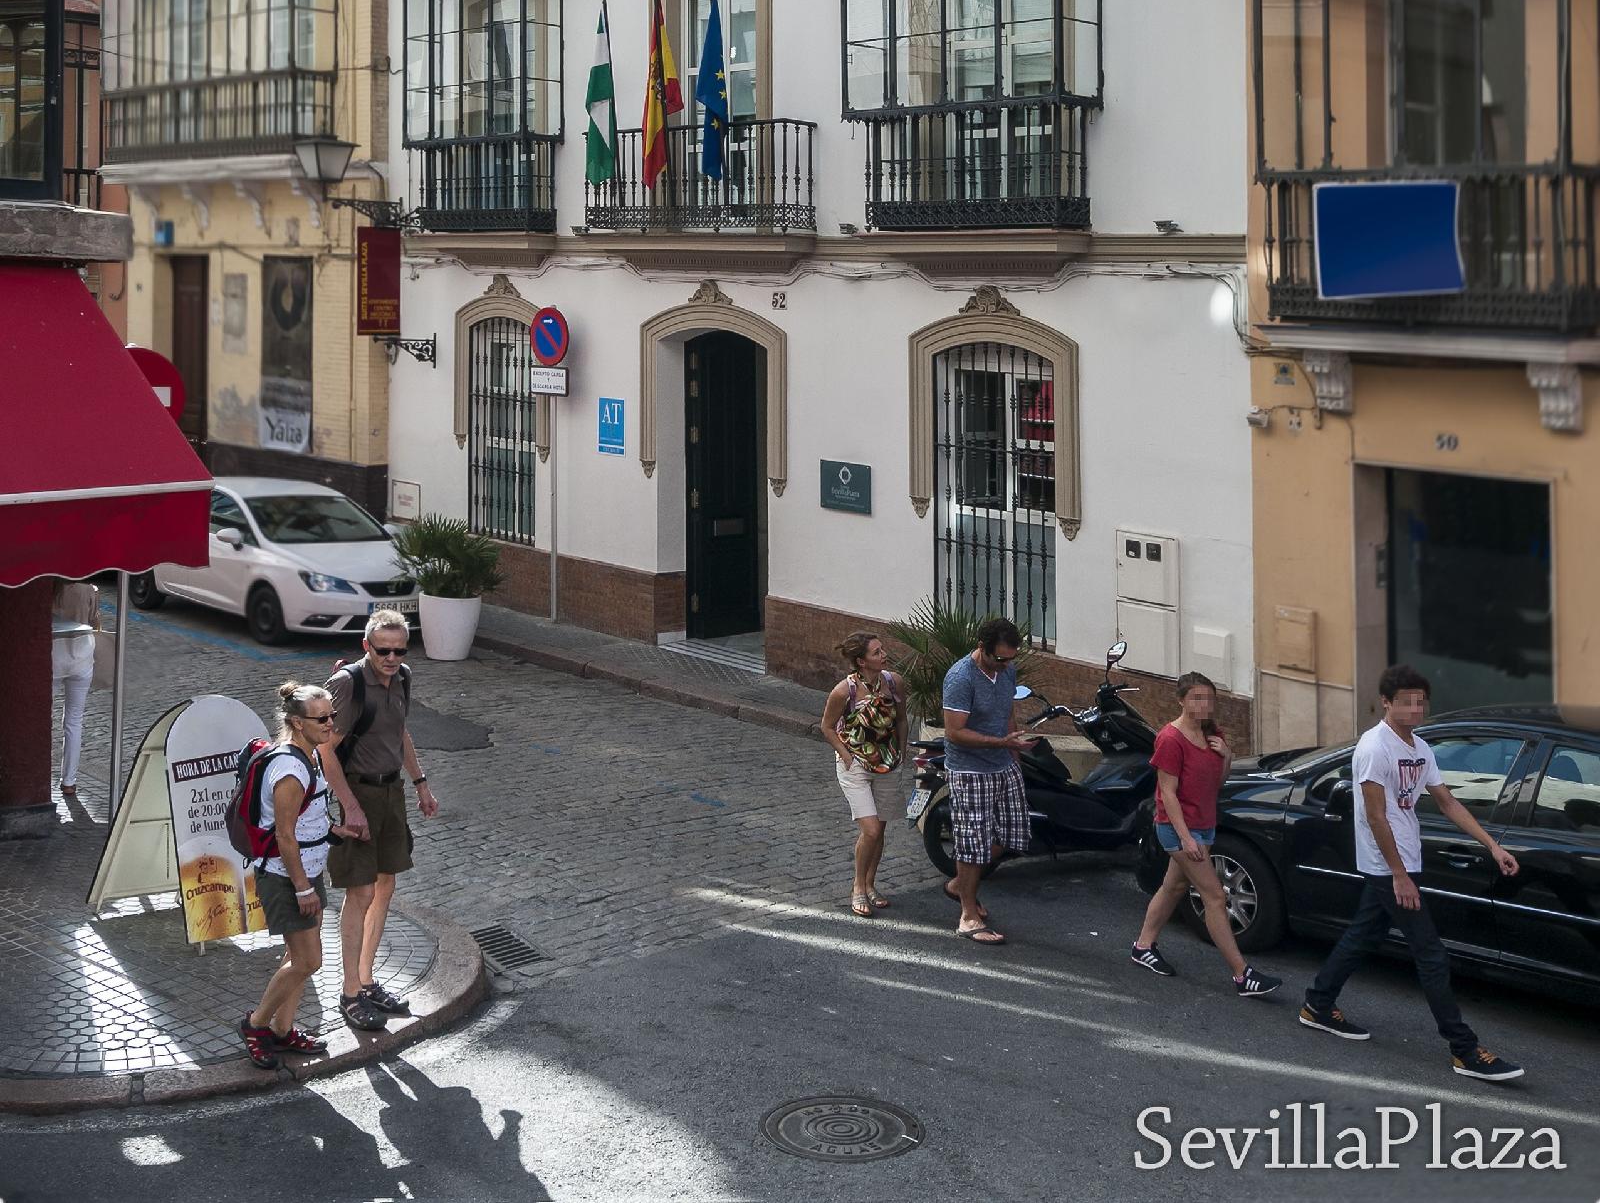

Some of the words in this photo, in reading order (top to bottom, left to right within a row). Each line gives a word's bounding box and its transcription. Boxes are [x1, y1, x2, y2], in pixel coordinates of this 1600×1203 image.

[772, 292, 786, 309] 52
[601, 403, 622, 424] AT
[1435, 434, 1459, 451] 50
[176, 762, 199, 779] HORA
[199, 759, 212, 774] DE
[211, 757, 223, 772] LA
[190, 787, 209, 803] 2x1
[211, 790, 223, 801] en
[188, 806, 199, 818] de
[190, 821, 201, 833] de
[186, 882, 235, 901] Cruzcampo
